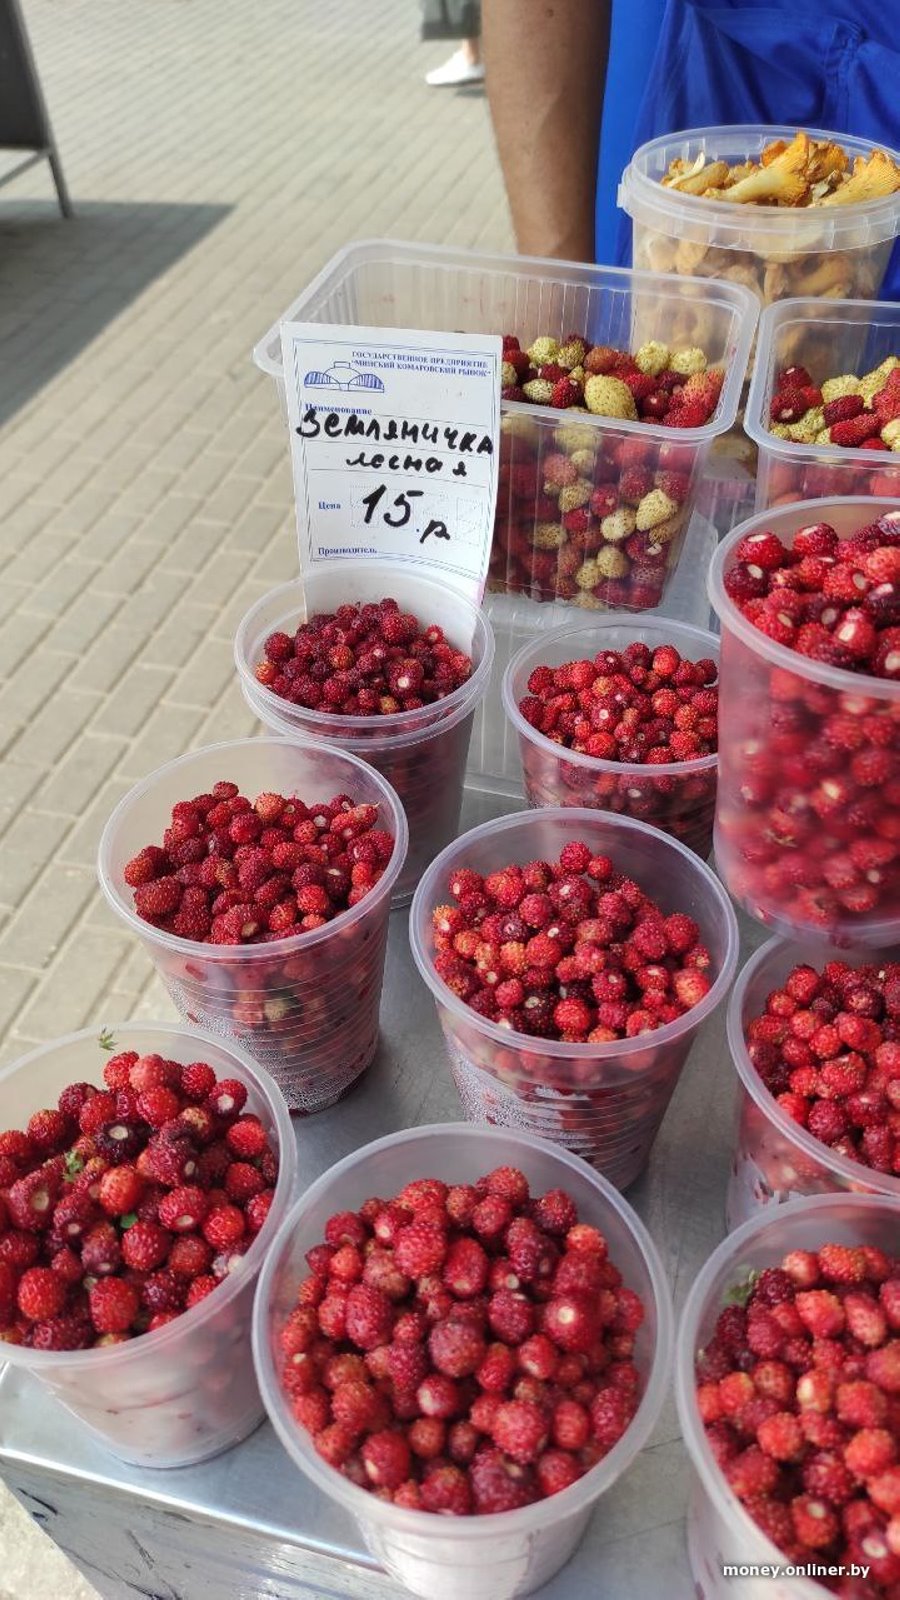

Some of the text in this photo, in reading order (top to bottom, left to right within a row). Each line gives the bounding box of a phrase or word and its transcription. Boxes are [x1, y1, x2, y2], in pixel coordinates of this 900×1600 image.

[352, 351, 488, 369] ГОСУДАРСТВЕННОЕ ПРЕДПРИЯТИЕ
[397, 363, 456, 375] КОМАРОВСКИЙ
[318, 501, 342, 510] Цена
